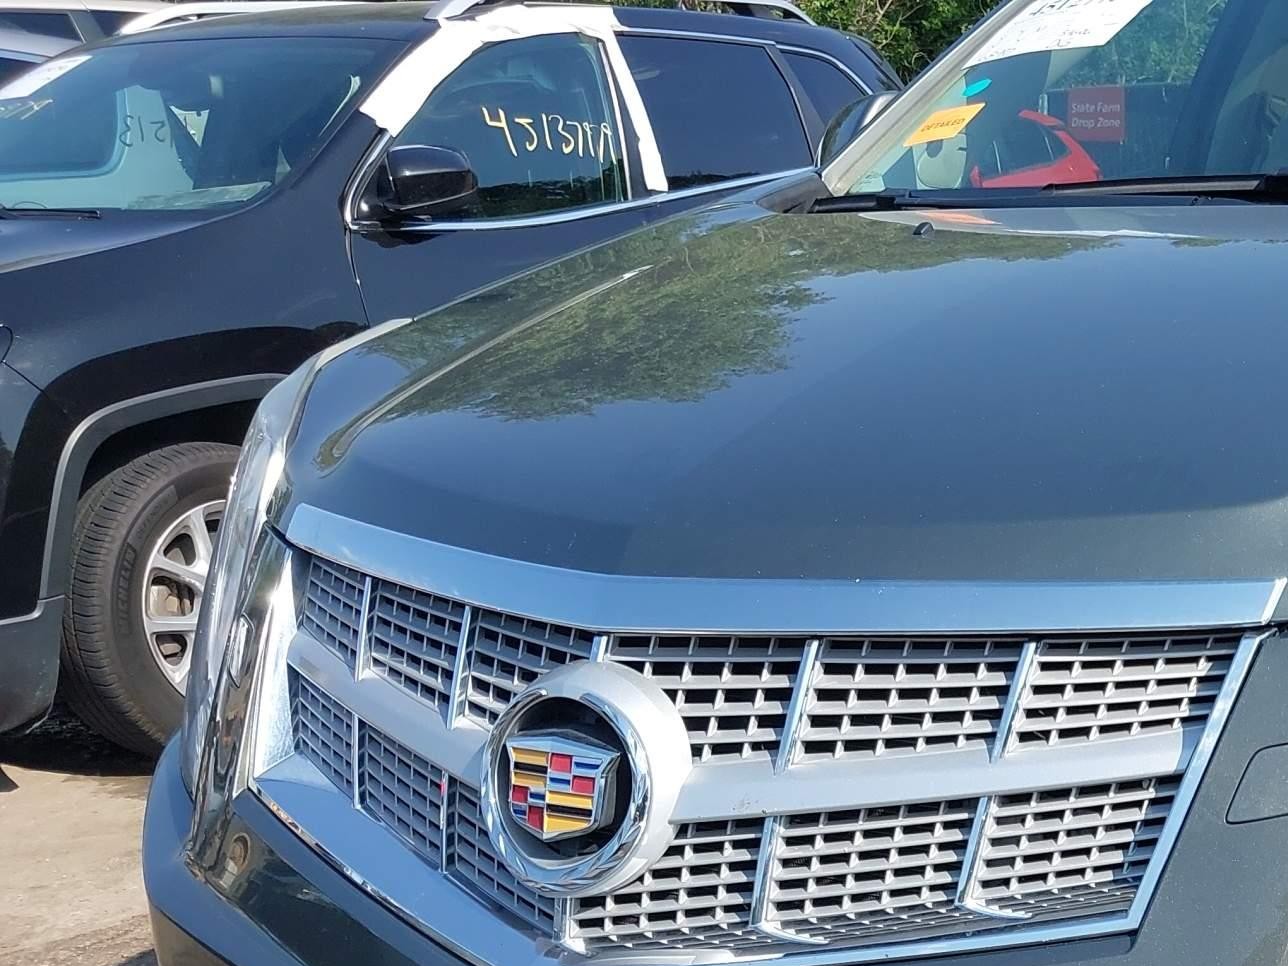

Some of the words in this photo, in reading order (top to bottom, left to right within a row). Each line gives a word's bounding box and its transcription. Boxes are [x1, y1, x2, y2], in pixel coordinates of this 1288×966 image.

[1071, 103, 1095, 113] State
[1097, 101, 1121, 113] Farm
[1071, 117, 1095, 130] Drop
[1097, 117, 1121, 128] Zone
